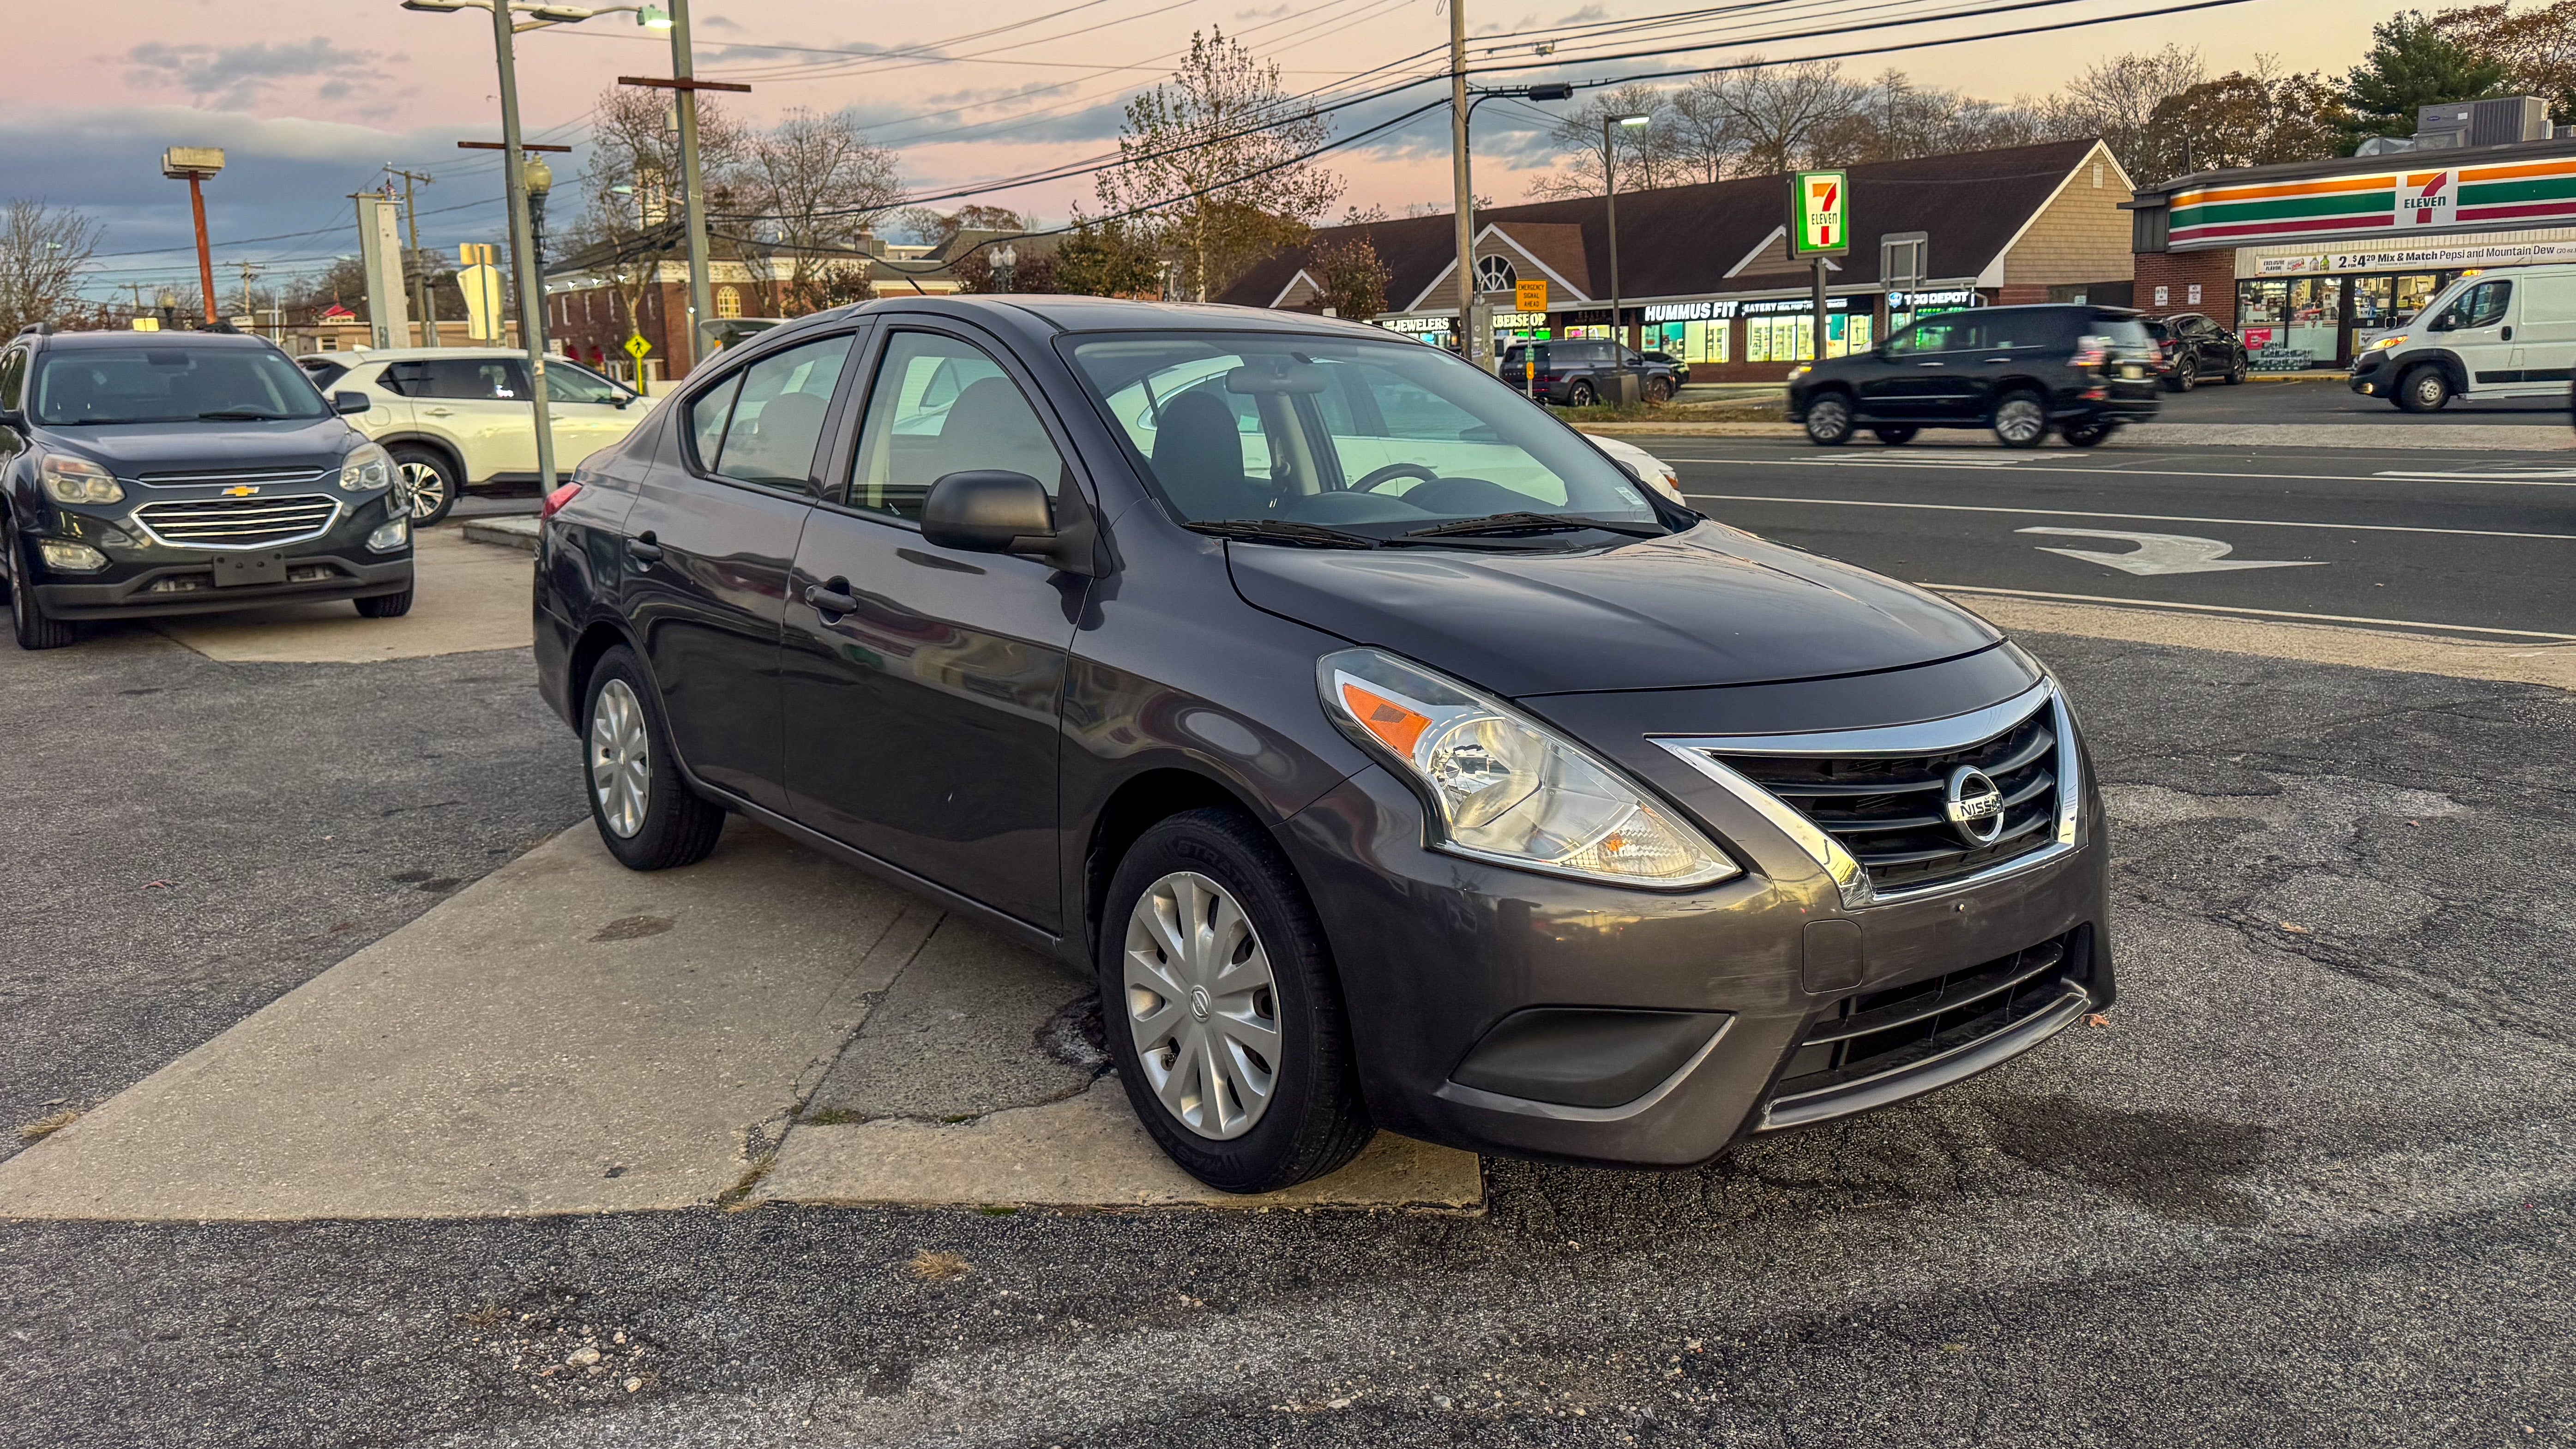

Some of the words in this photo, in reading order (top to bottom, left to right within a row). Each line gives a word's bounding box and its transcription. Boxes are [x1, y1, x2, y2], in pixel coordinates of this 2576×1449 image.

[2338, 256, 2347, 268] 2
[2378, 254, 2395, 262] Mix
[2406, 251, 2438, 261] Match
[2440, 249, 2464, 261] Pepsi
[2467, 249, 2484, 258] and
[2486, 246, 2531, 257] Mountain
[2534, 246, 2554, 254] Dew
[1929, 291, 1969, 304] DEPOT
[1645, 303, 1711, 321] HUMMUS
[1713, 301, 1739, 318] FIT
[1395, 318, 1449, 332] JEWELERS
